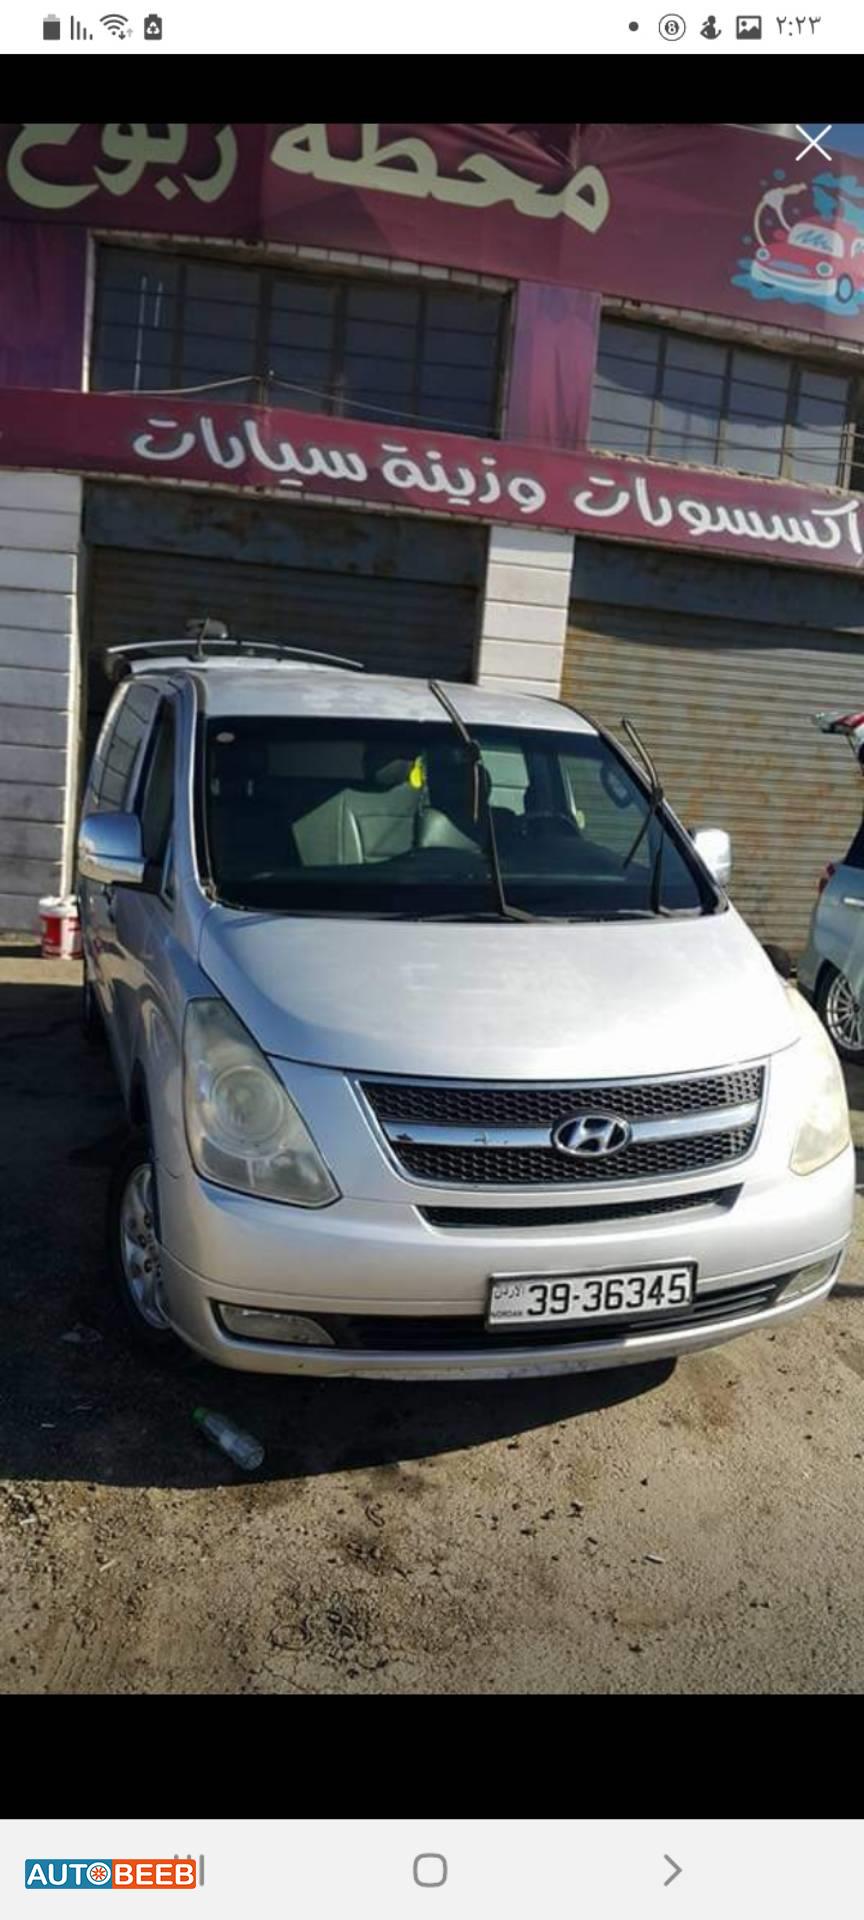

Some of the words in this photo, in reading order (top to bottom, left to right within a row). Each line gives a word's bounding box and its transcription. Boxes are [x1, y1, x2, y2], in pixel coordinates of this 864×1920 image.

[132, 416, 368, 486] سيارات
[381, 443, 546, 514] وزينة
[527, 1273, 687, 1316] 39-36345
